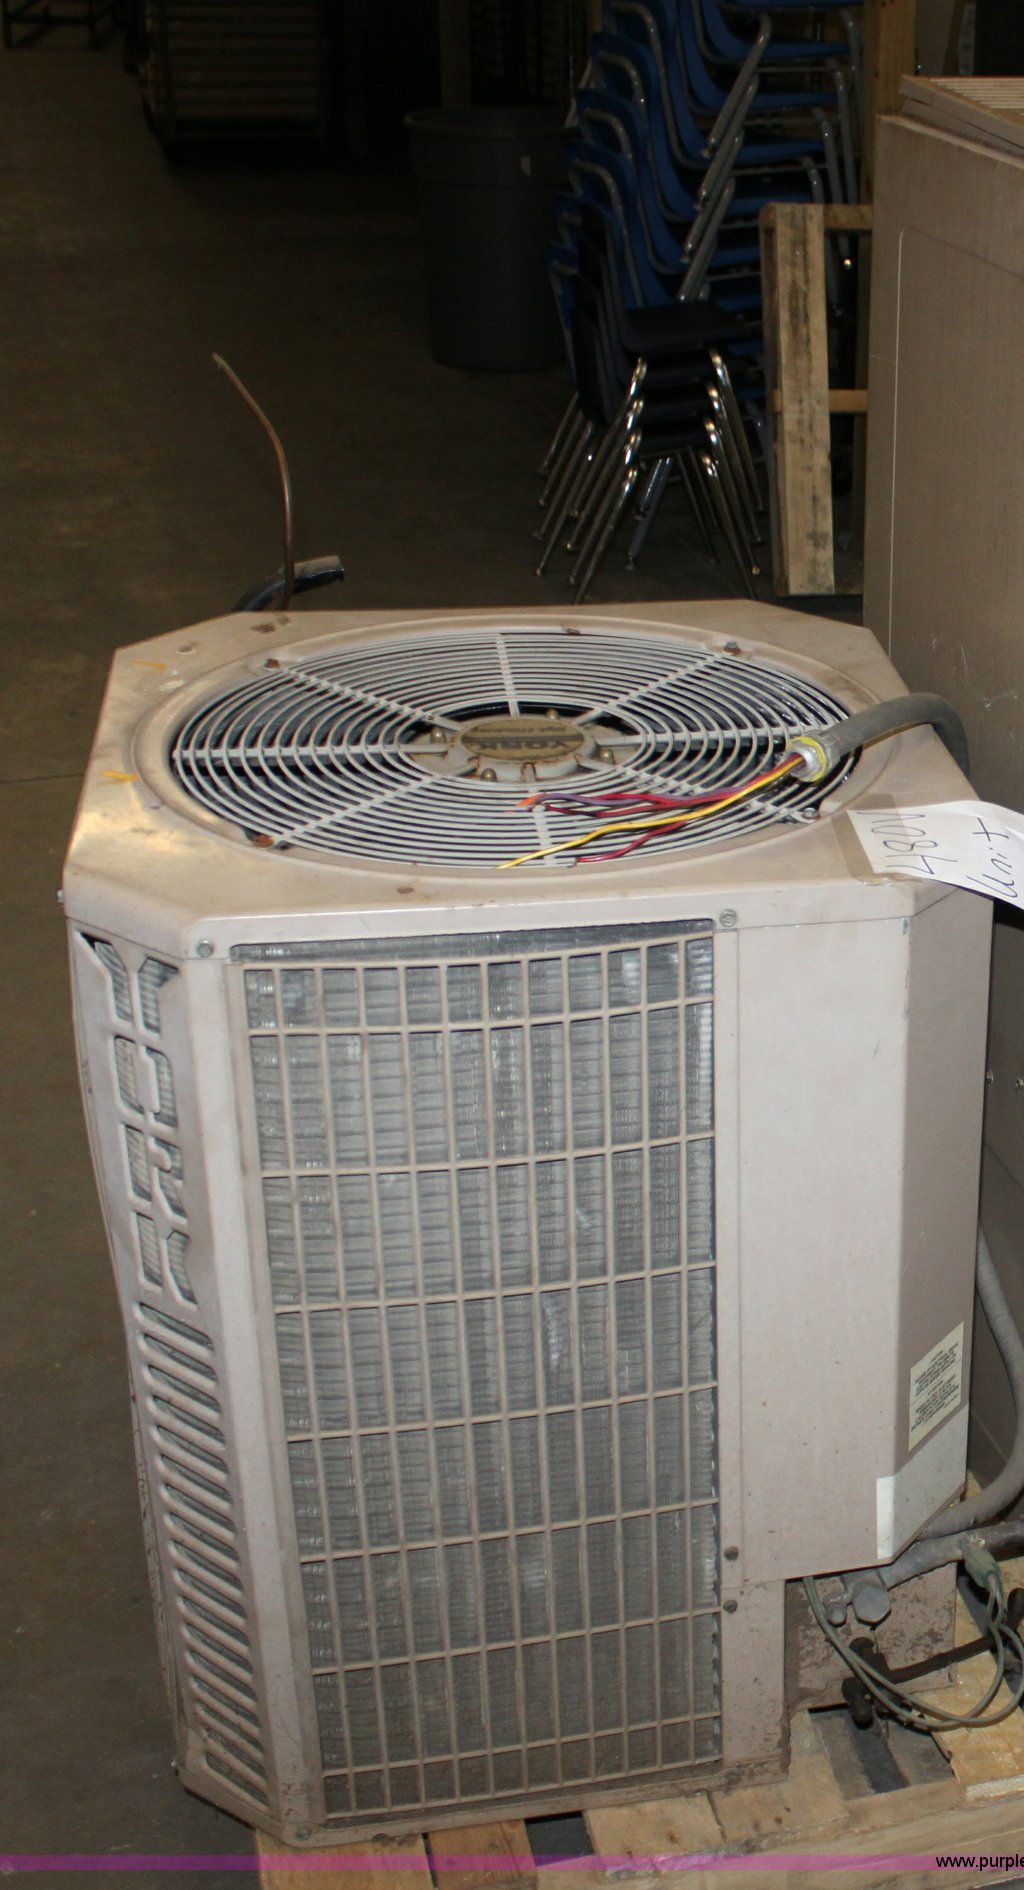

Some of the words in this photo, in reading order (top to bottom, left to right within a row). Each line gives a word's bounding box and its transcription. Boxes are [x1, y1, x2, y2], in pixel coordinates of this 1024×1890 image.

[480, 736, 567, 749] YORK
[857, 811, 958, 875] 480V
[966, 817, 1018, 898] Unit
